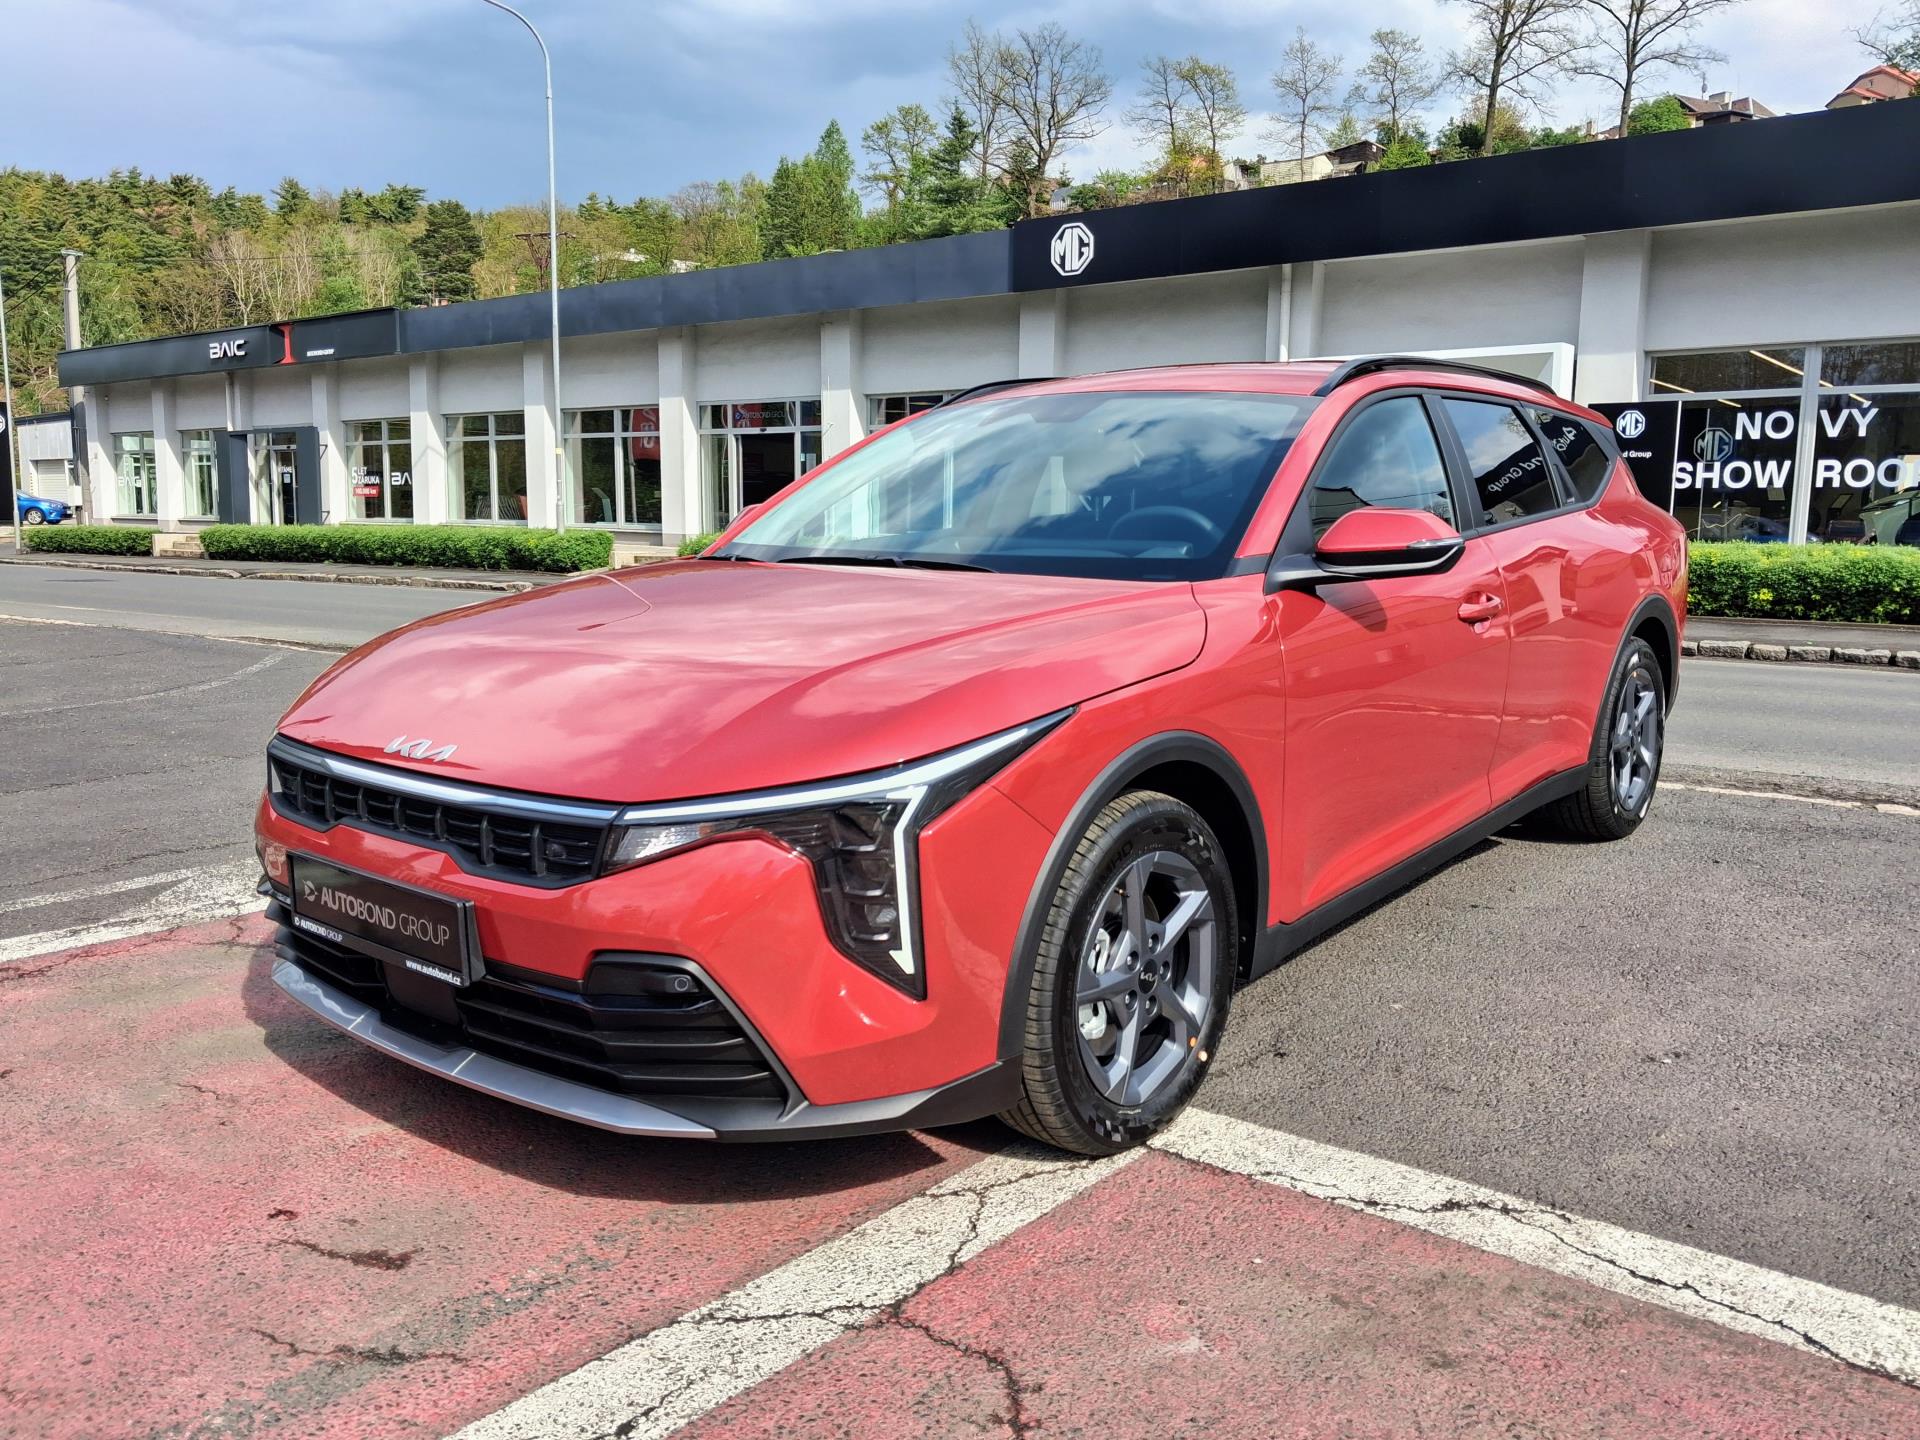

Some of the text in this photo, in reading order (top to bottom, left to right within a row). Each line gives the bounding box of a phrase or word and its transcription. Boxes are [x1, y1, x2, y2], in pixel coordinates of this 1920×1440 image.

[1053, 225, 1091, 273] MG
[209, 340, 246, 359] BAIC
[1618, 412, 1644, 437] MG
[1629, 450, 1652, 459] Group
[352, 466, 358, 484] 5
[1675, 460, 1791, 489] SHOW
[300, 919, 327, 937] AUTOBOND
[320, 886, 450, 946] AUTOBOND GROUP
[405, 959, 462, 987] www.autobond.cz
